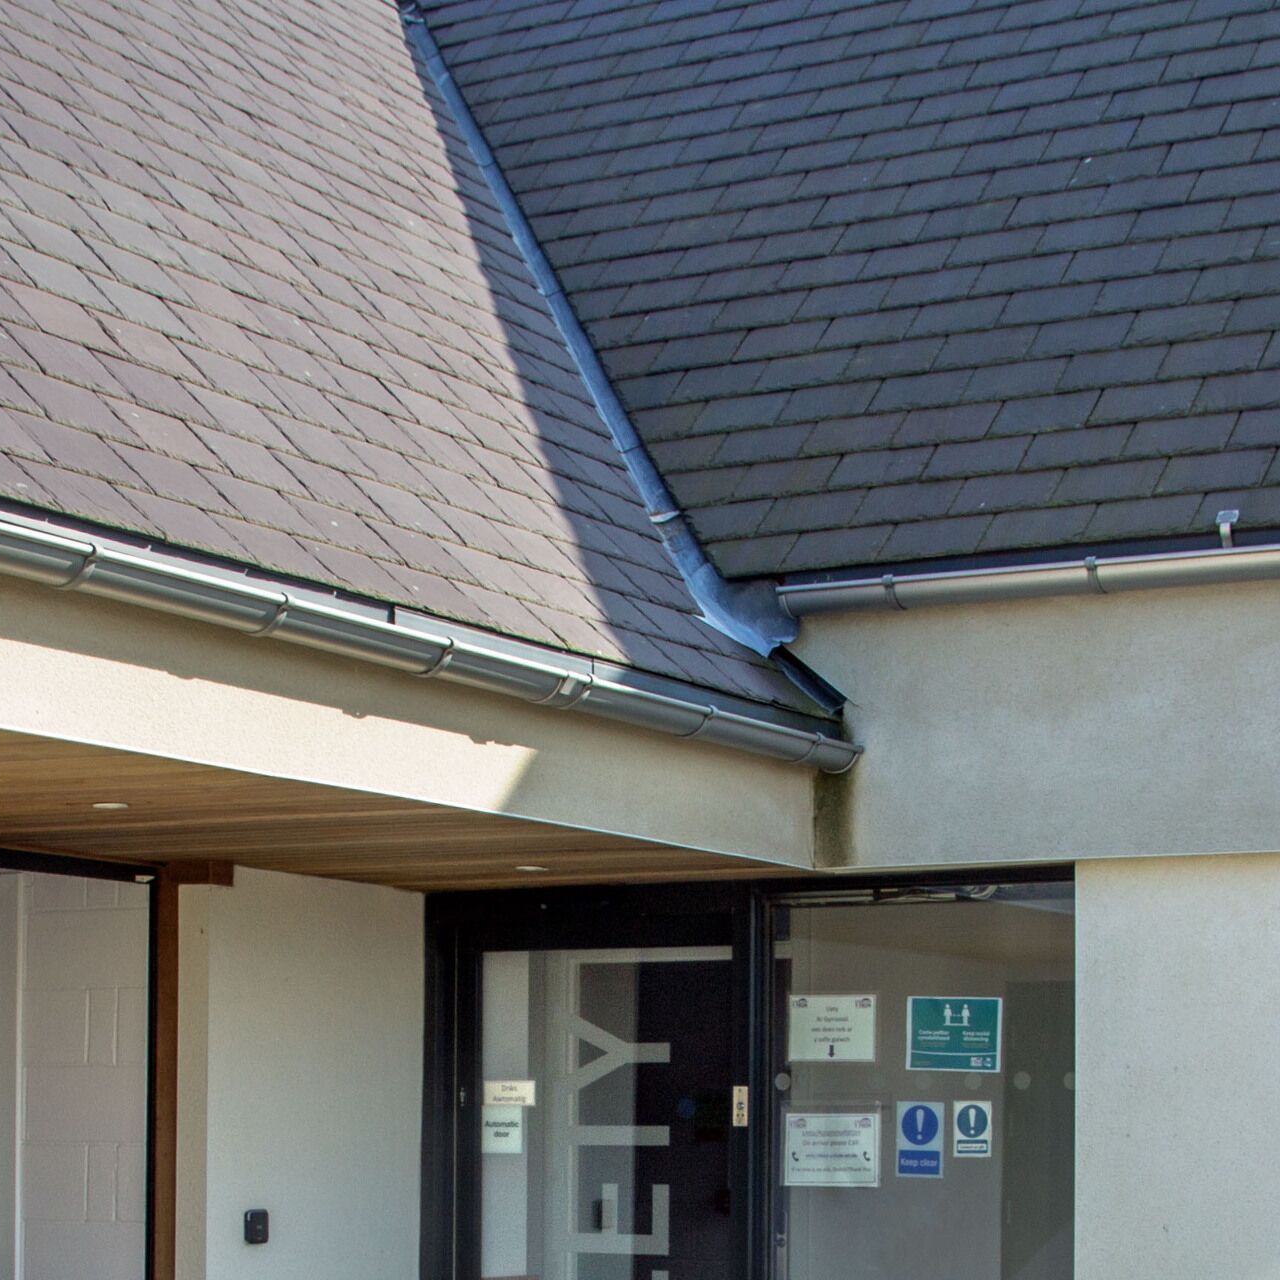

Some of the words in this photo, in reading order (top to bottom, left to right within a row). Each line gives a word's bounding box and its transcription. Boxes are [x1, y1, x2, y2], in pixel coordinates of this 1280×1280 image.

[485, 1120, 519, 1128] Automatic
[900, 1157, 920, 1168] Keep
[920, 1157, 938, 1167] clear
